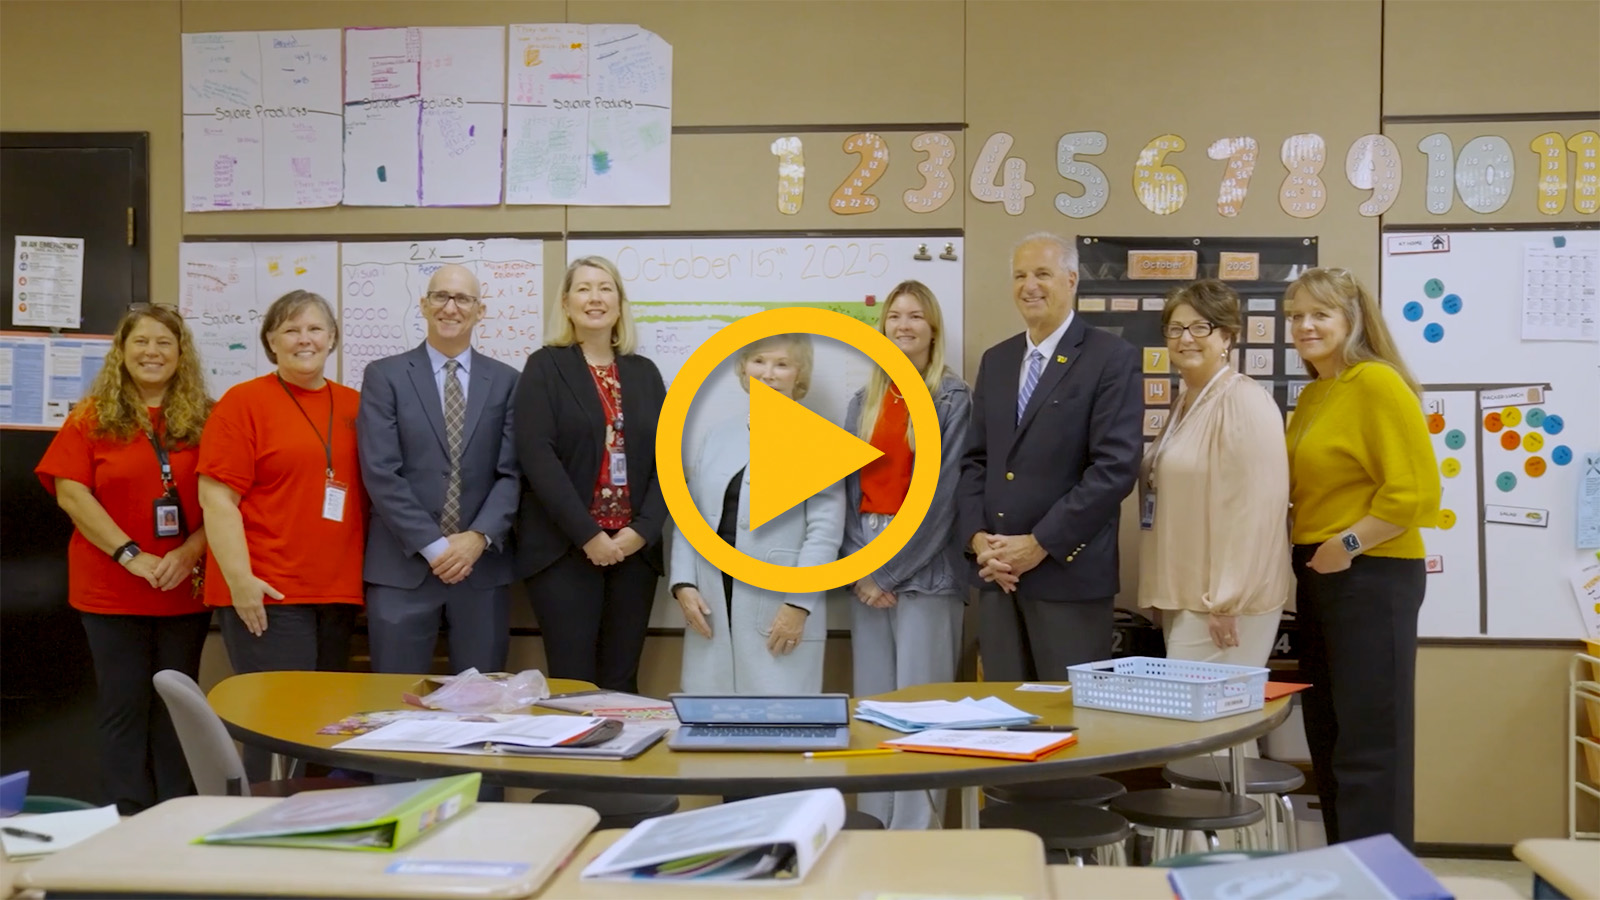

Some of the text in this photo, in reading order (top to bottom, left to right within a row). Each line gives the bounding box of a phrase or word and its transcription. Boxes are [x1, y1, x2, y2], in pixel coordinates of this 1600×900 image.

[215, 106, 252, 122] Square
[829, 132, 889, 215] 2
[903, 132, 956, 213] 3
[969, 132, 1035, 216] 4
[1054, 131, 1111, 219] 5
[1131, 134, 1188, 215] 6
[1207, 136, 1260, 217] 7
[1279, 133, 1327, 218] 8
[1345, 133, 1402, 217] 9
[1417, 131, 1515, 215] 10
[1530, 130, 1600, 215] 11
[410, 243, 426, 260] 2
[614, 243, 741, 282] October
[801, 242, 890, 281] 2025
[1142, 260, 1251, 270] October 2025
[1256, 320, 1266, 337] 3
[1151, 352, 1161, 368] 7
[1251, 353, 1267, 369] 10
[1150, 383, 1164, 398] 14
[1150, 415, 1164, 430] 21
[1275, 632, 1291, 654] 4
